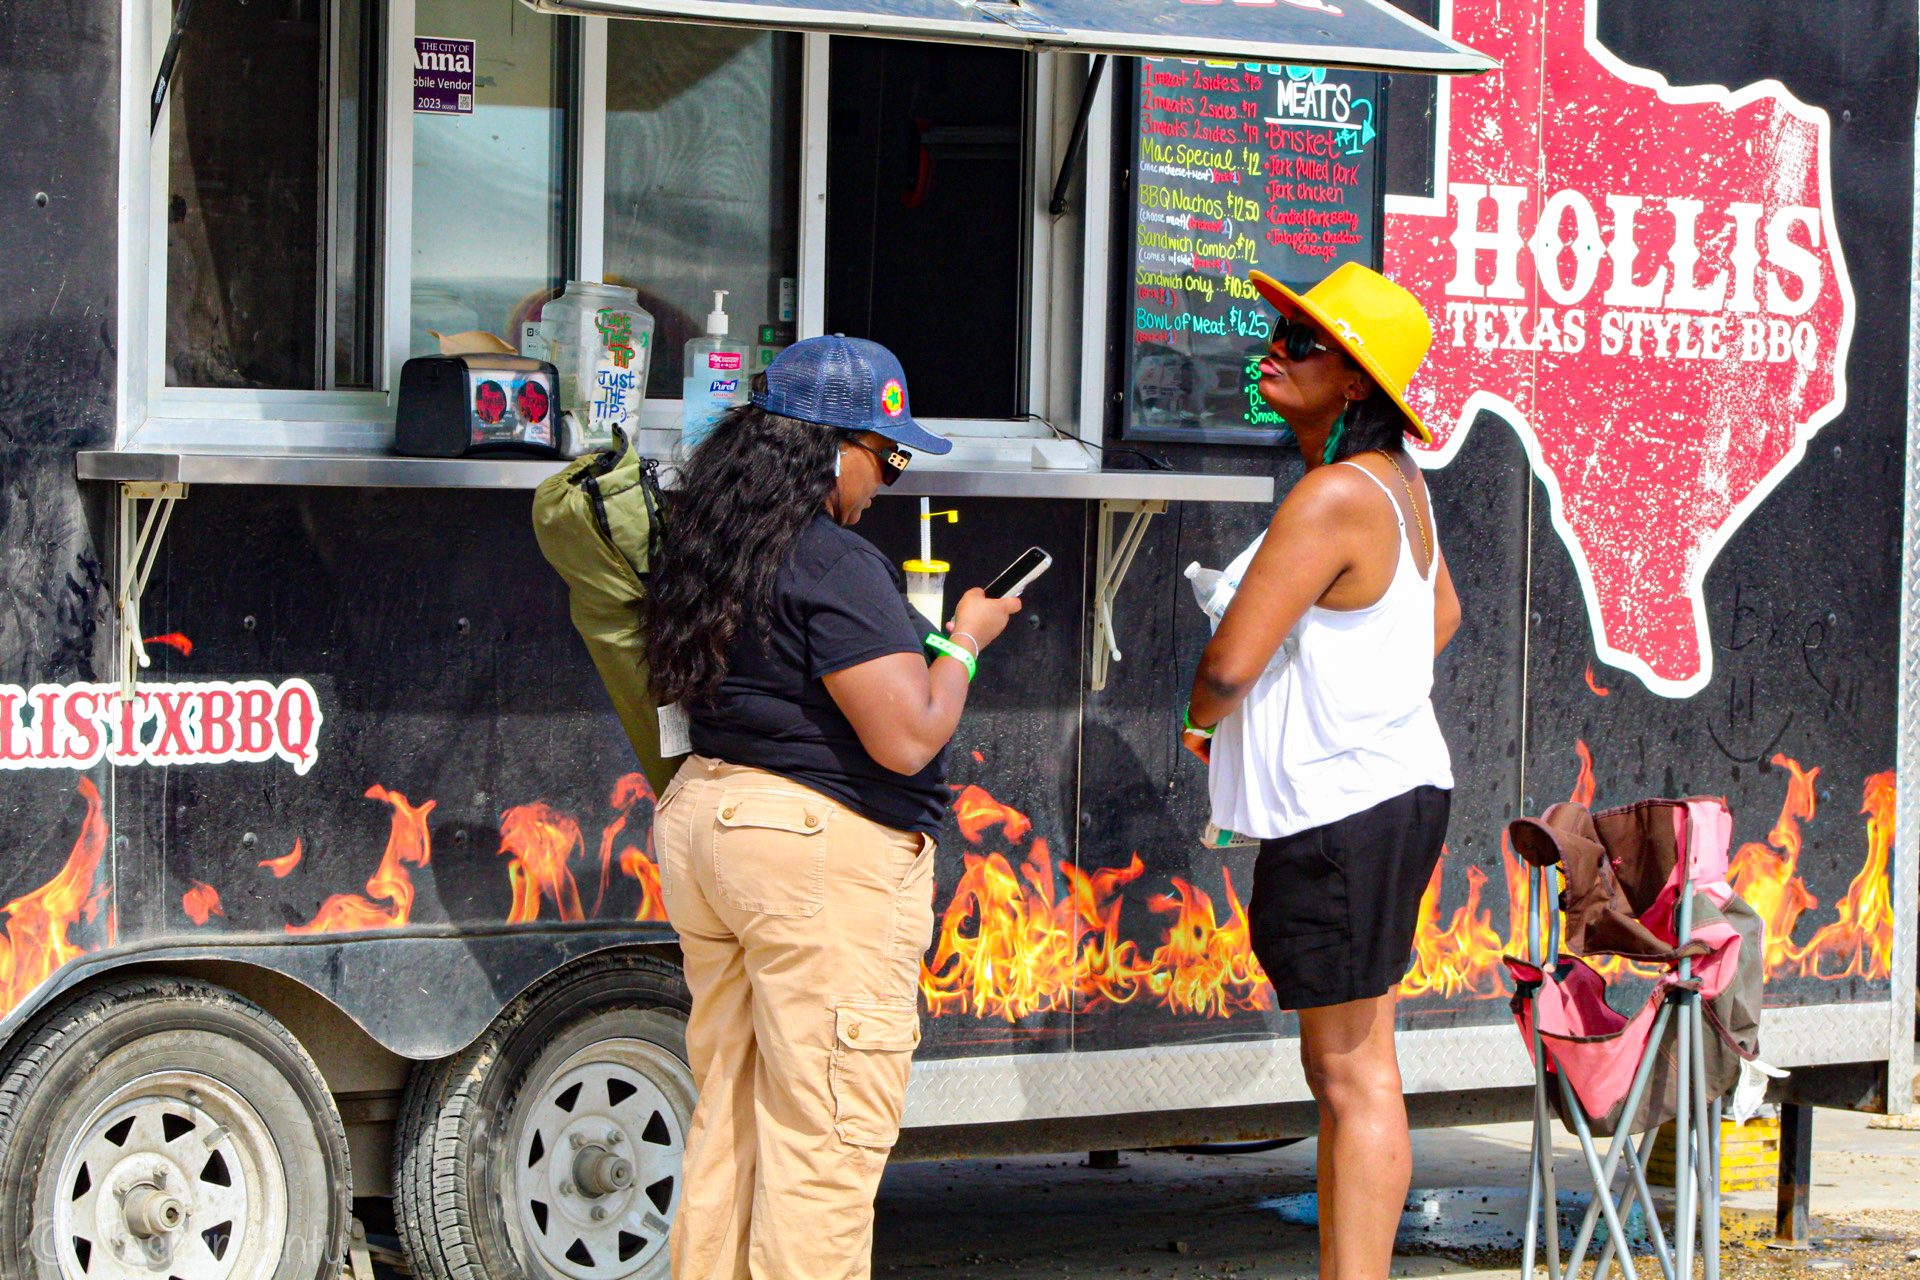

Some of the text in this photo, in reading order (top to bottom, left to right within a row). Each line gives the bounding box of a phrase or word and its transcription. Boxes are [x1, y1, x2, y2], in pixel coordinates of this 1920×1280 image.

[421, 42, 470, 53] THE CITY OF
[413, 76, 472, 90] obile Vendor
[418, 97, 441, 109] 2023
[1277, 80, 1351, 122] MEATS
[1267, 122, 1340, 159] Brisket
[1141, 137, 1174, 163] Mac
[1243, 146, 1262, 175] $12
[1268, 154, 1293, 177] Jerk
[1139, 184, 1170, 210] BBQ
[1268, 179, 1344, 205] Jerk Chicken
[1269, 204, 1307, 227] Candied
[1137, 224, 1192, 252] Sandwich
[1236, 232, 1258, 264] $12
[1445, 182, 1823, 317] HOLLIS
[1136, 266, 1183, 289] Sandwich
[1185, 275, 1214, 303] Only
[1230, 306, 1270, 339] $6.25
[600, 327, 632, 346] THE
[1446, 302, 1820, 371] TEXAS STYLE BBQ
[608, 345, 635, 369] TIP
[602, 386, 627, 405] THE
